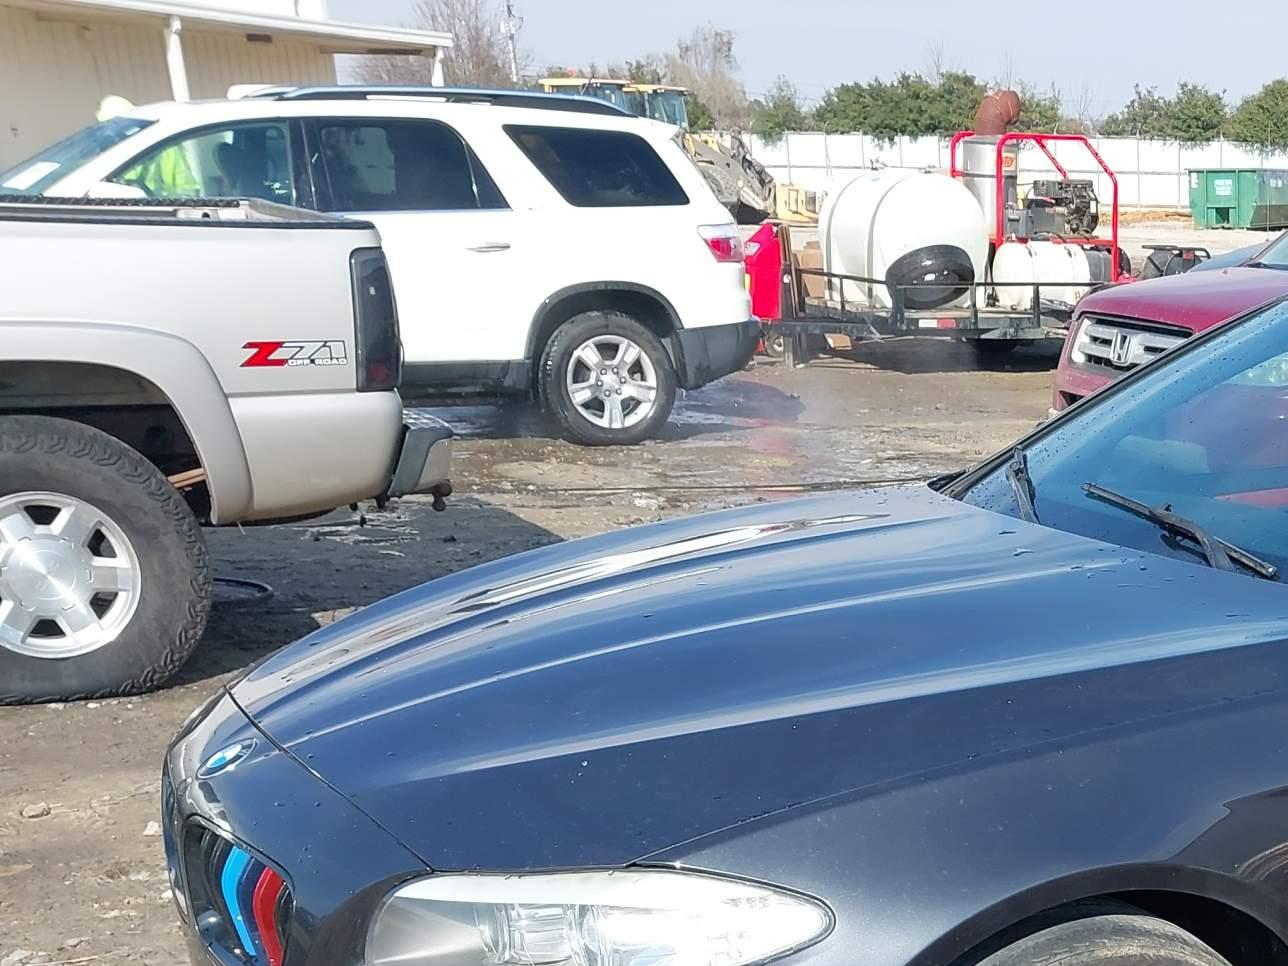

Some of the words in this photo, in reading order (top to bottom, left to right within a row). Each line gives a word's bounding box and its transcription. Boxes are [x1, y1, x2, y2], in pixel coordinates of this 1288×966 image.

[241, 340, 347, 367] Z71
[287, 359, 311, 367] OFF
[314, 358, 347, 366] ROAD
